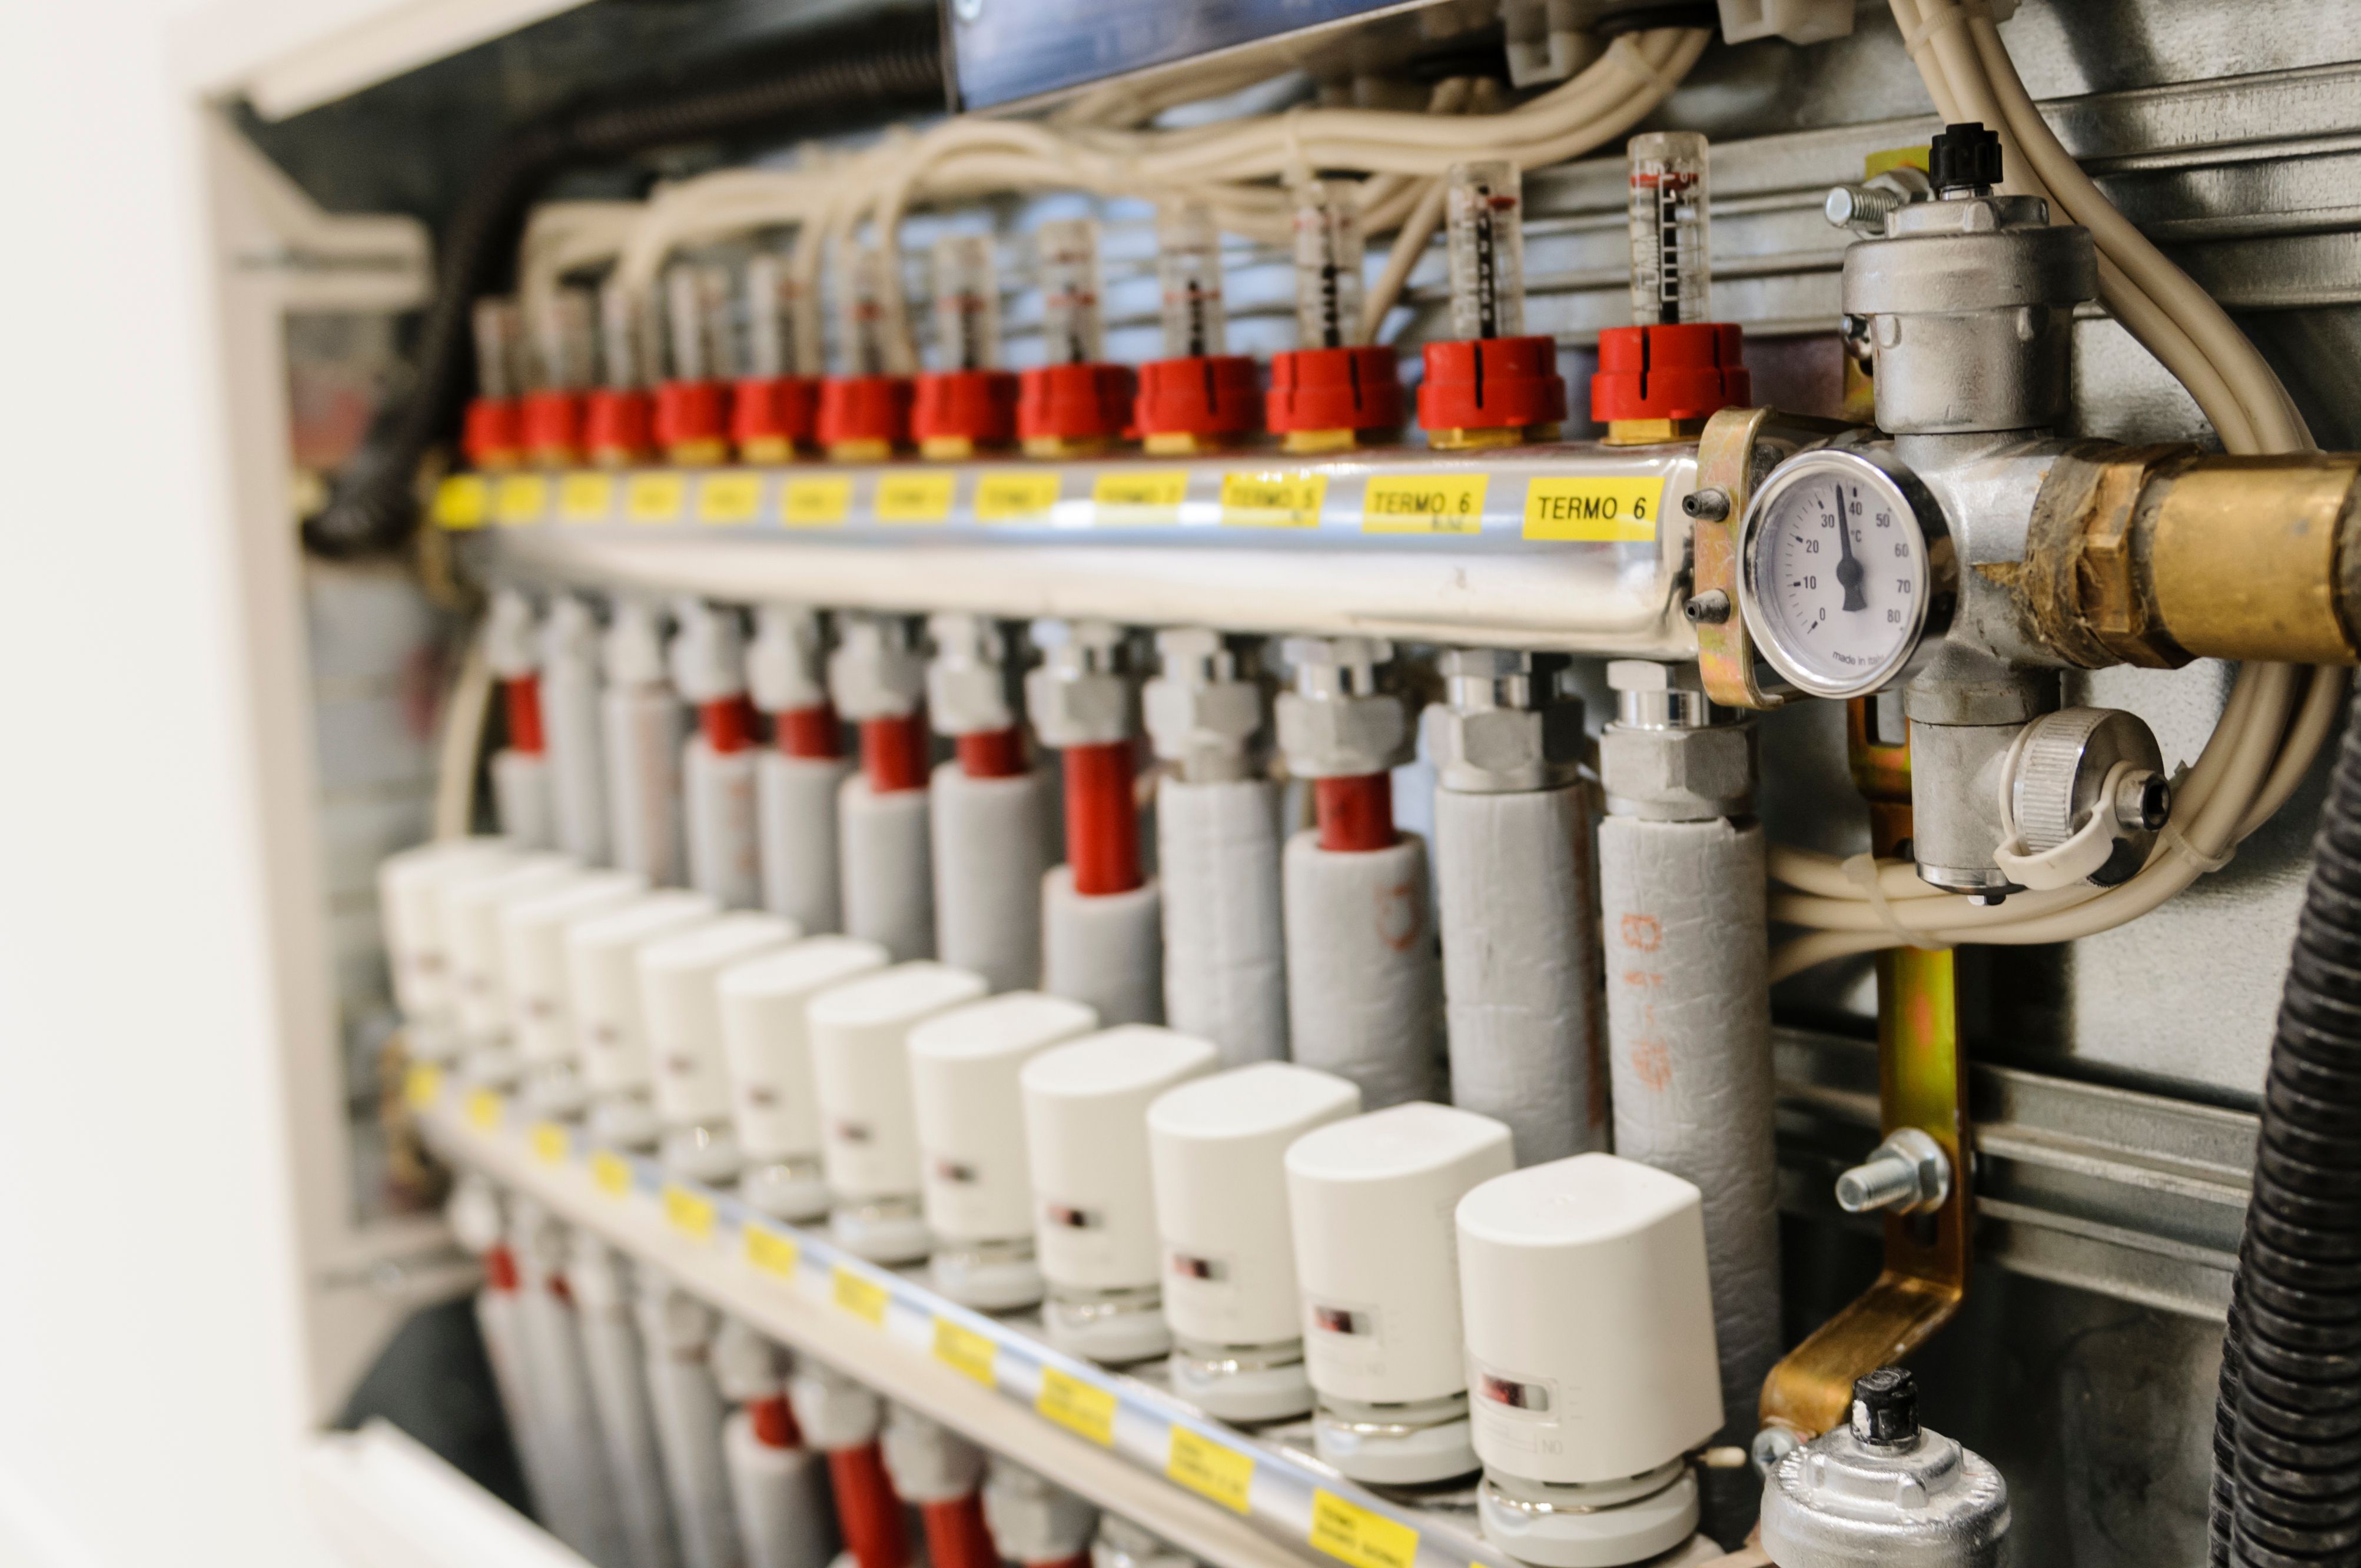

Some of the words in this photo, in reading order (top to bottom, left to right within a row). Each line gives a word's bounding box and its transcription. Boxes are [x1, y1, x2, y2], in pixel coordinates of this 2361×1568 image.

[1374, 491, 1446, 514] TERMO
[1459, 491, 1472, 514] 6
[1538, 496, 1618, 520] TERMO
[1633, 497, 1646, 520] 6
[1849, 501, 1862, 516] 40
[1821, 514, 1835, 528] 30
[1876, 513, 1890, 528] 50
[1851, 530, 1862, 543] °C
[1806, 540, 1819, 553] 20
[1895, 543, 1910, 557] 60
[1803, 576, 1817, 590] 10
[1897, 579, 1911, 594] 70
[1819, 607, 1826, 621] 0
[1887, 609, 1901, 623] 80
[1832, 651, 1856, 665] made
[1858, 656, 1865, 666] in
[1542, 1439, 1563, 1456] NO
